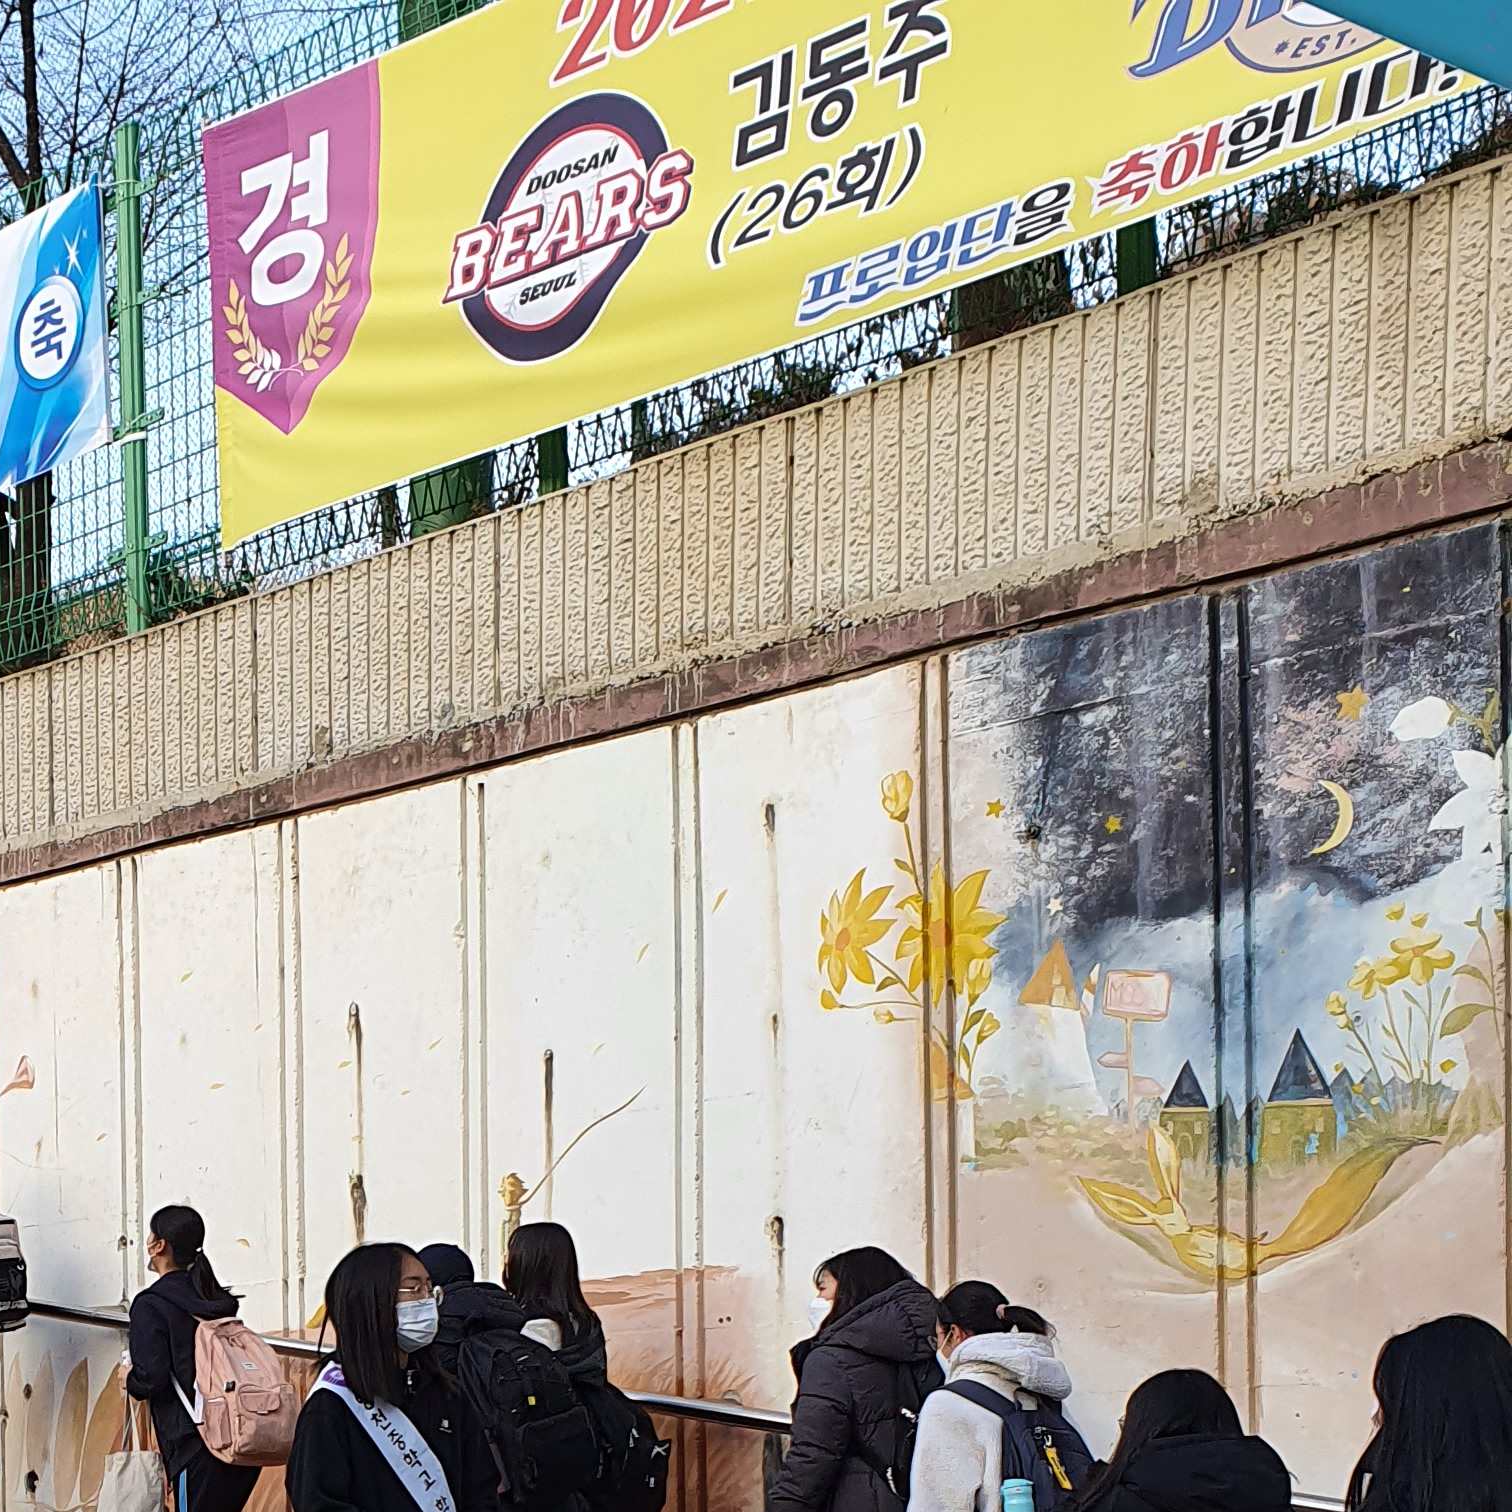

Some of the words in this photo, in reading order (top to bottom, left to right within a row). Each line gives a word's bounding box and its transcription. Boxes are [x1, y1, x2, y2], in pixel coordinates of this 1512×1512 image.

[732, 0, 948, 168] 김동주
[237, 130, 329, 307] 경
[442, 147, 694, 304] BEARS
[525, 144, 620, 196] DOOSAN
[710, 126, 921, 266] (26회)
[518, 270, 577, 305] SEOUL
[797, 181, 1073, 322] 프로입단을
[31, 298, 67, 361] 축
